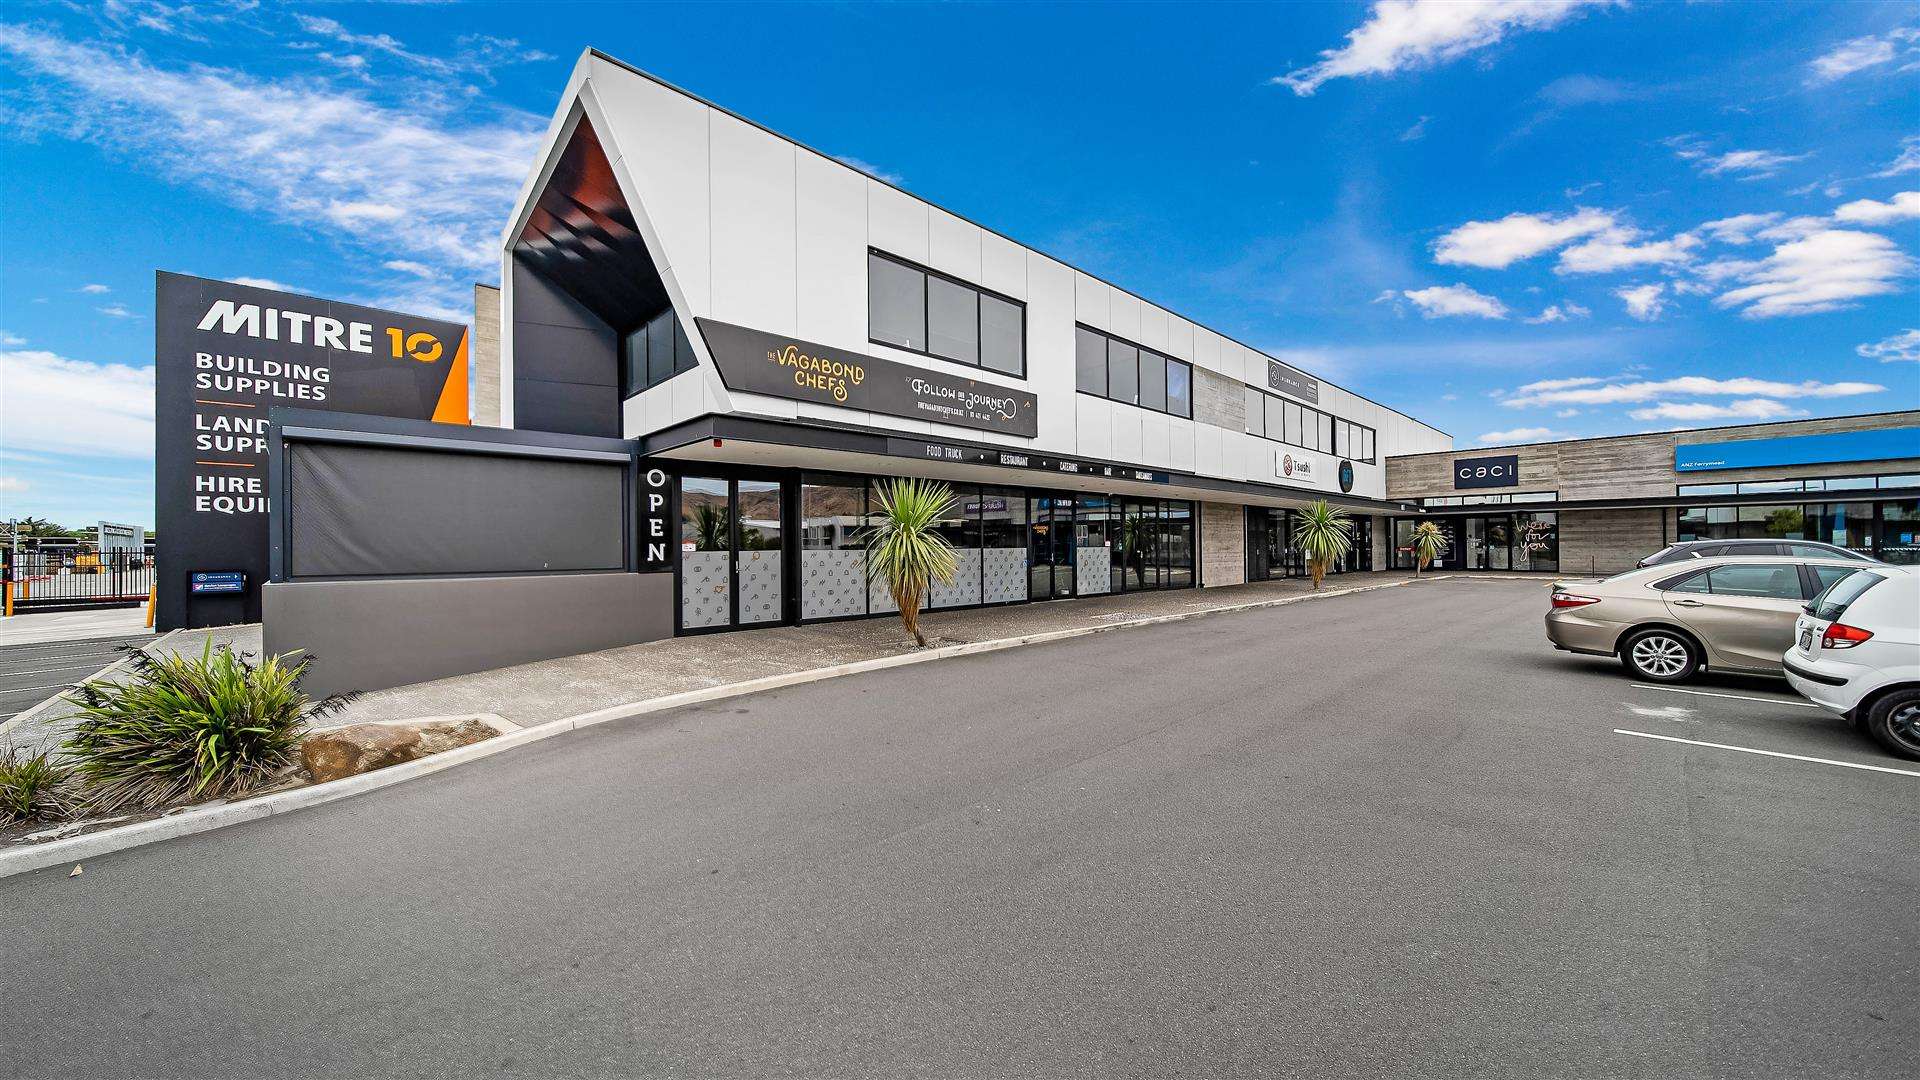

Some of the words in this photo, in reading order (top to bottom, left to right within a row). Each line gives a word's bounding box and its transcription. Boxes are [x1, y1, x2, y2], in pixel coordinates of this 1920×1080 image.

[197, 300, 373, 353] MITRE
[386, 327, 443, 363] 10
[196, 352, 330, 382] BUILDING
[777, 345, 865, 385] VAGABOND
[196, 373, 326, 401] SUPPLIES
[795, 371, 848, 402] CHEFS
[911, 378, 956, 399] FOLLOW
[965, 392, 1017, 419] JOURNEY
[926, 445, 942, 458] FOOD
[945, 447, 963, 460] TRUCK
[1000, 454, 1028, 467] RESTAURANT
[195, 475, 262, 494] HIRE
[1459, 464, 1513, 479] caci
[647, 468, 666, 562] OPEN
[1525, 528, 1550, 542] for
[1520, 541, 1550, 562] you
